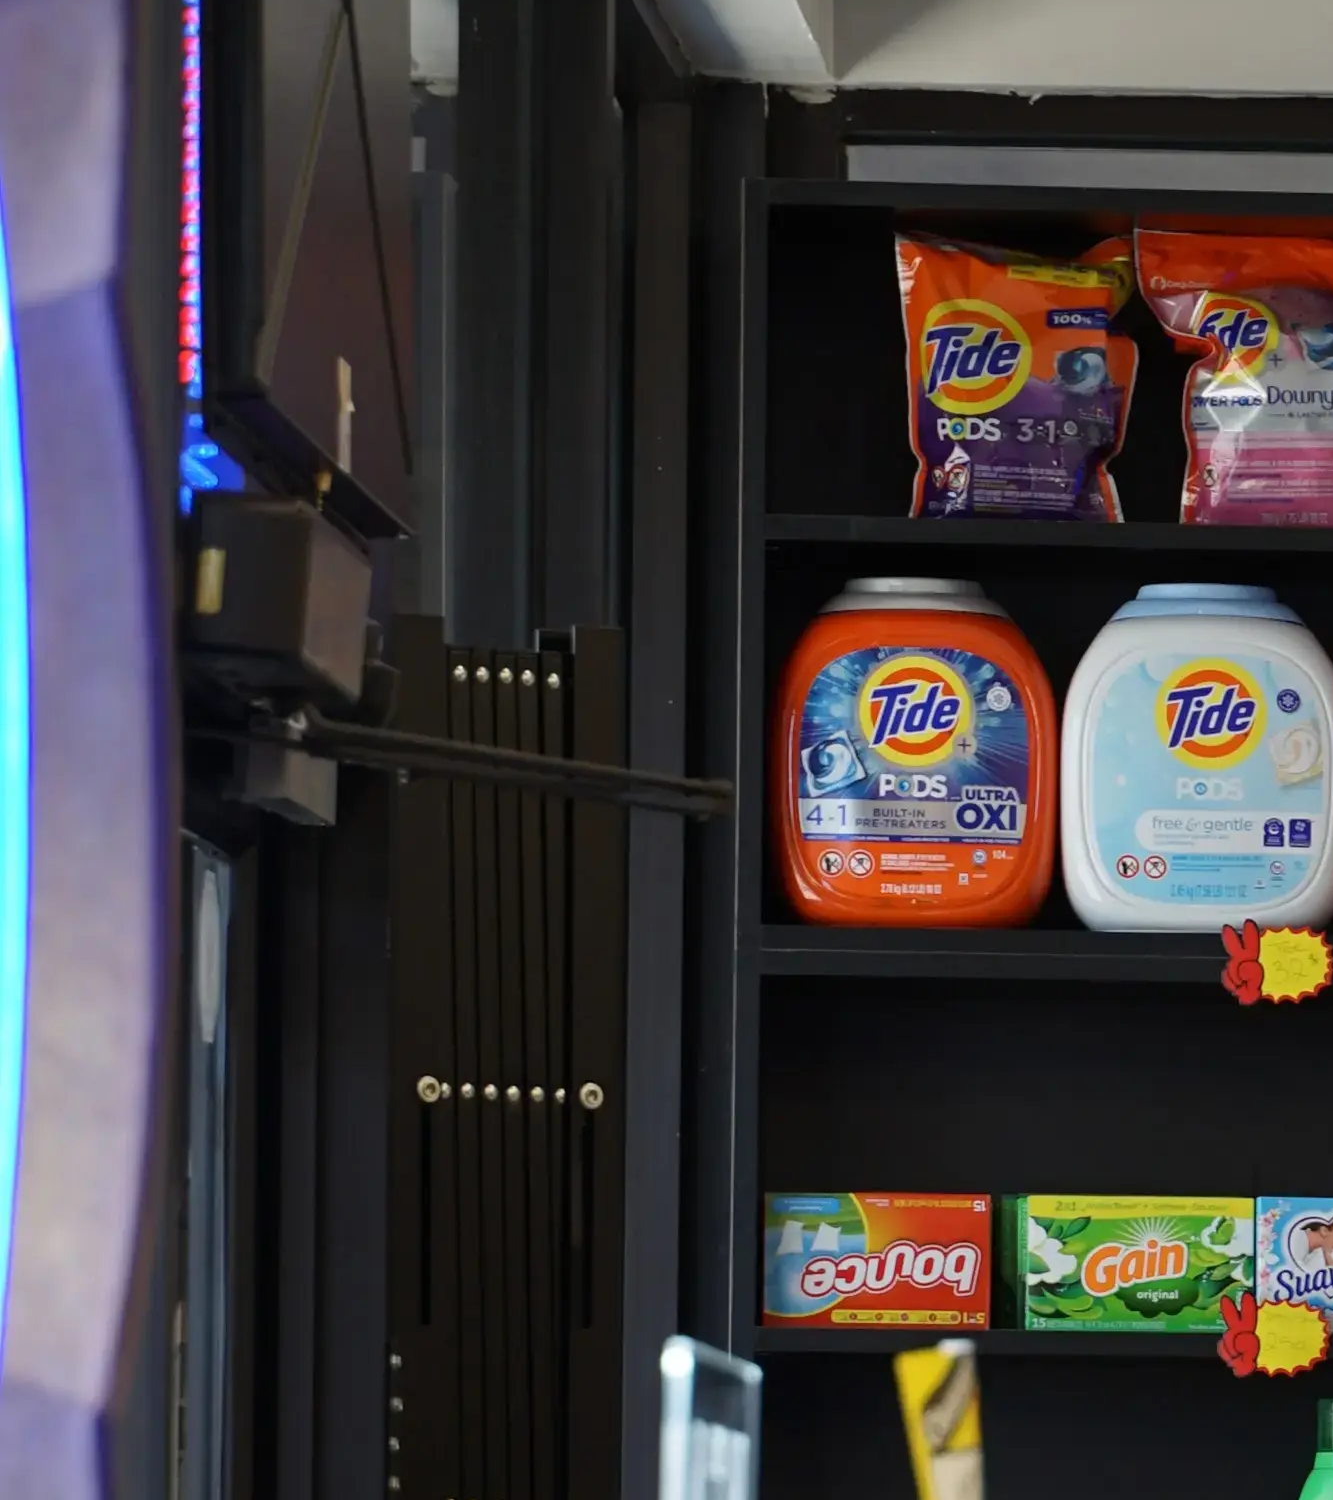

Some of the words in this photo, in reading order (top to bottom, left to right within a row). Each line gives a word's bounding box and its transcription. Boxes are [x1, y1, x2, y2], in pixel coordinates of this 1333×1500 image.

[925, 327, 1022, 397] Tide
[937, 417, 1000, 442] PODS
[868, 683, 960, 748] Tide
[1167, 686, 1255, 749] Tide
[879, 774, 947, 797] PODS
[966, 789, 1016, 801] ULTRA
[1177, 777, 1242, 800] PODS
[856, 819, 946, 829] PRE-TREATERS
[873, 809, 925, 818] BUILT-IN
[956, 803, 1017, 830] OXI
[1153, 816, 1183, 831] free
[1203, 817, 1253, 834] gentle
[801, 1240, 980, 1297] bounce
[1084, 1239, 1189, 1297] Gain
[1136, 1289, 1179, 1301] original
[1032, 1317, 1046, 1328] 15
